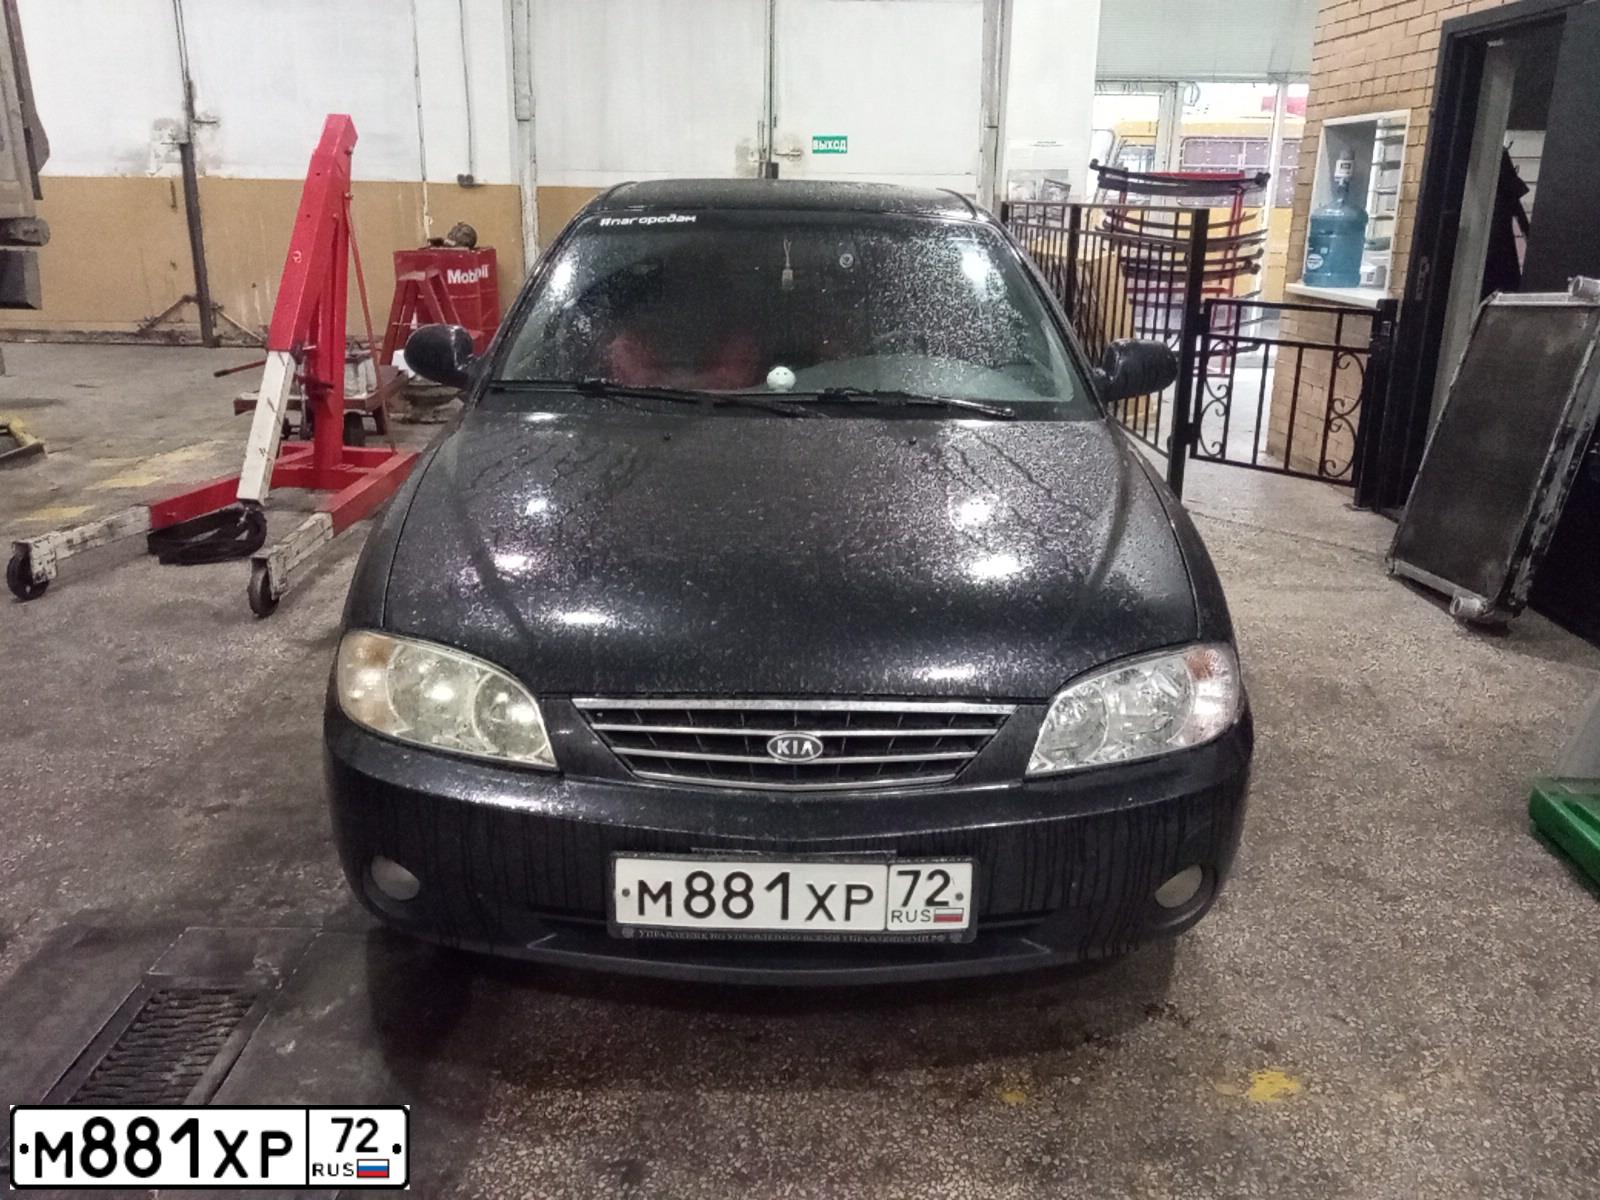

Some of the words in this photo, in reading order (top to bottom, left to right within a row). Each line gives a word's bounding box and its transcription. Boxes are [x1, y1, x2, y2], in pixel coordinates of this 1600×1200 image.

[812, 139, 848, 153] ВЫХОД
[777, 739, 814, 755] KIA
[897, 868, 951, 908] 72
[890, 909, 932, 923] RUS
